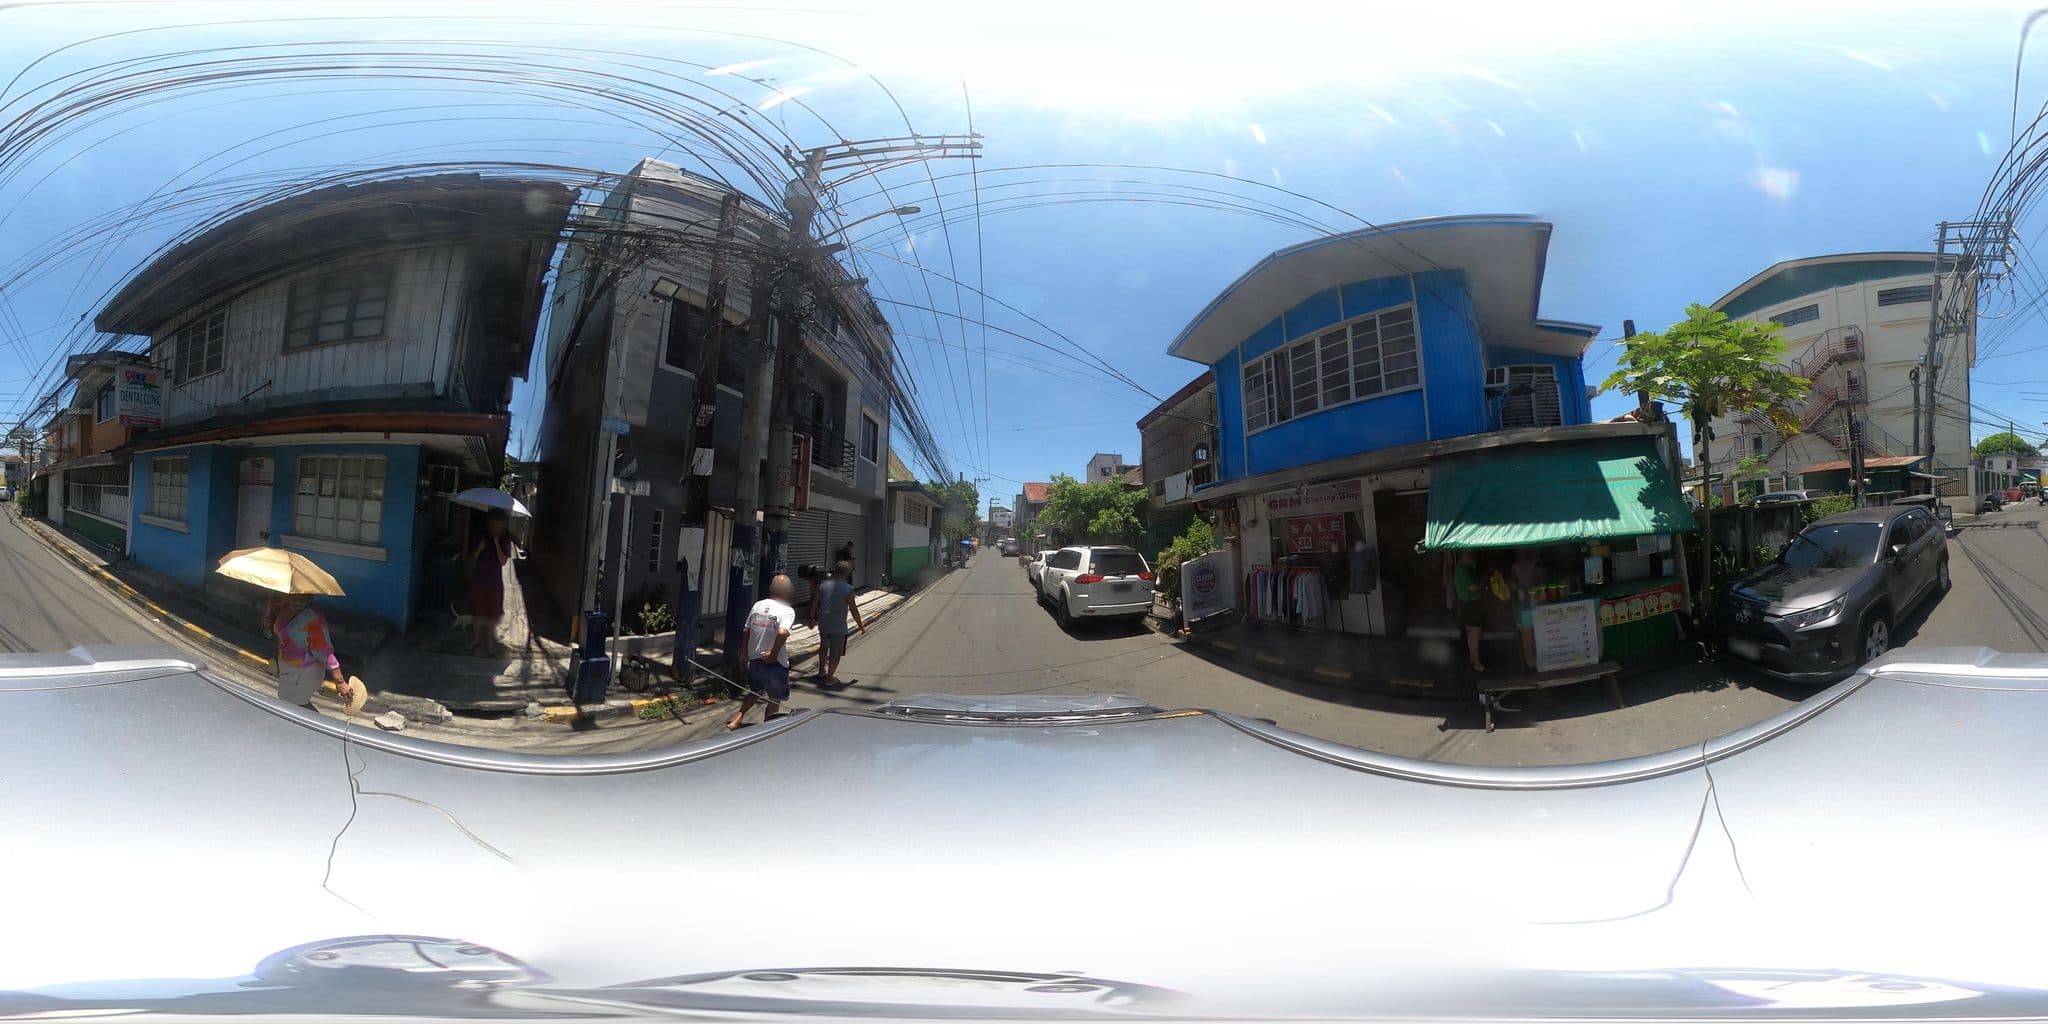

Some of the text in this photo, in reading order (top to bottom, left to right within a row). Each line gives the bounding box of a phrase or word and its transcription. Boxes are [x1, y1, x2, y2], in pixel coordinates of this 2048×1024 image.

[120, 390, 161, 407] DENTAL CLINIC
[1268, 495, 1302, 510] GRM
[1338, 490, 1360, 501] Shop
[1289, 520, 1341, 535] SALE
[1299, 537, 1311, 549] 35
